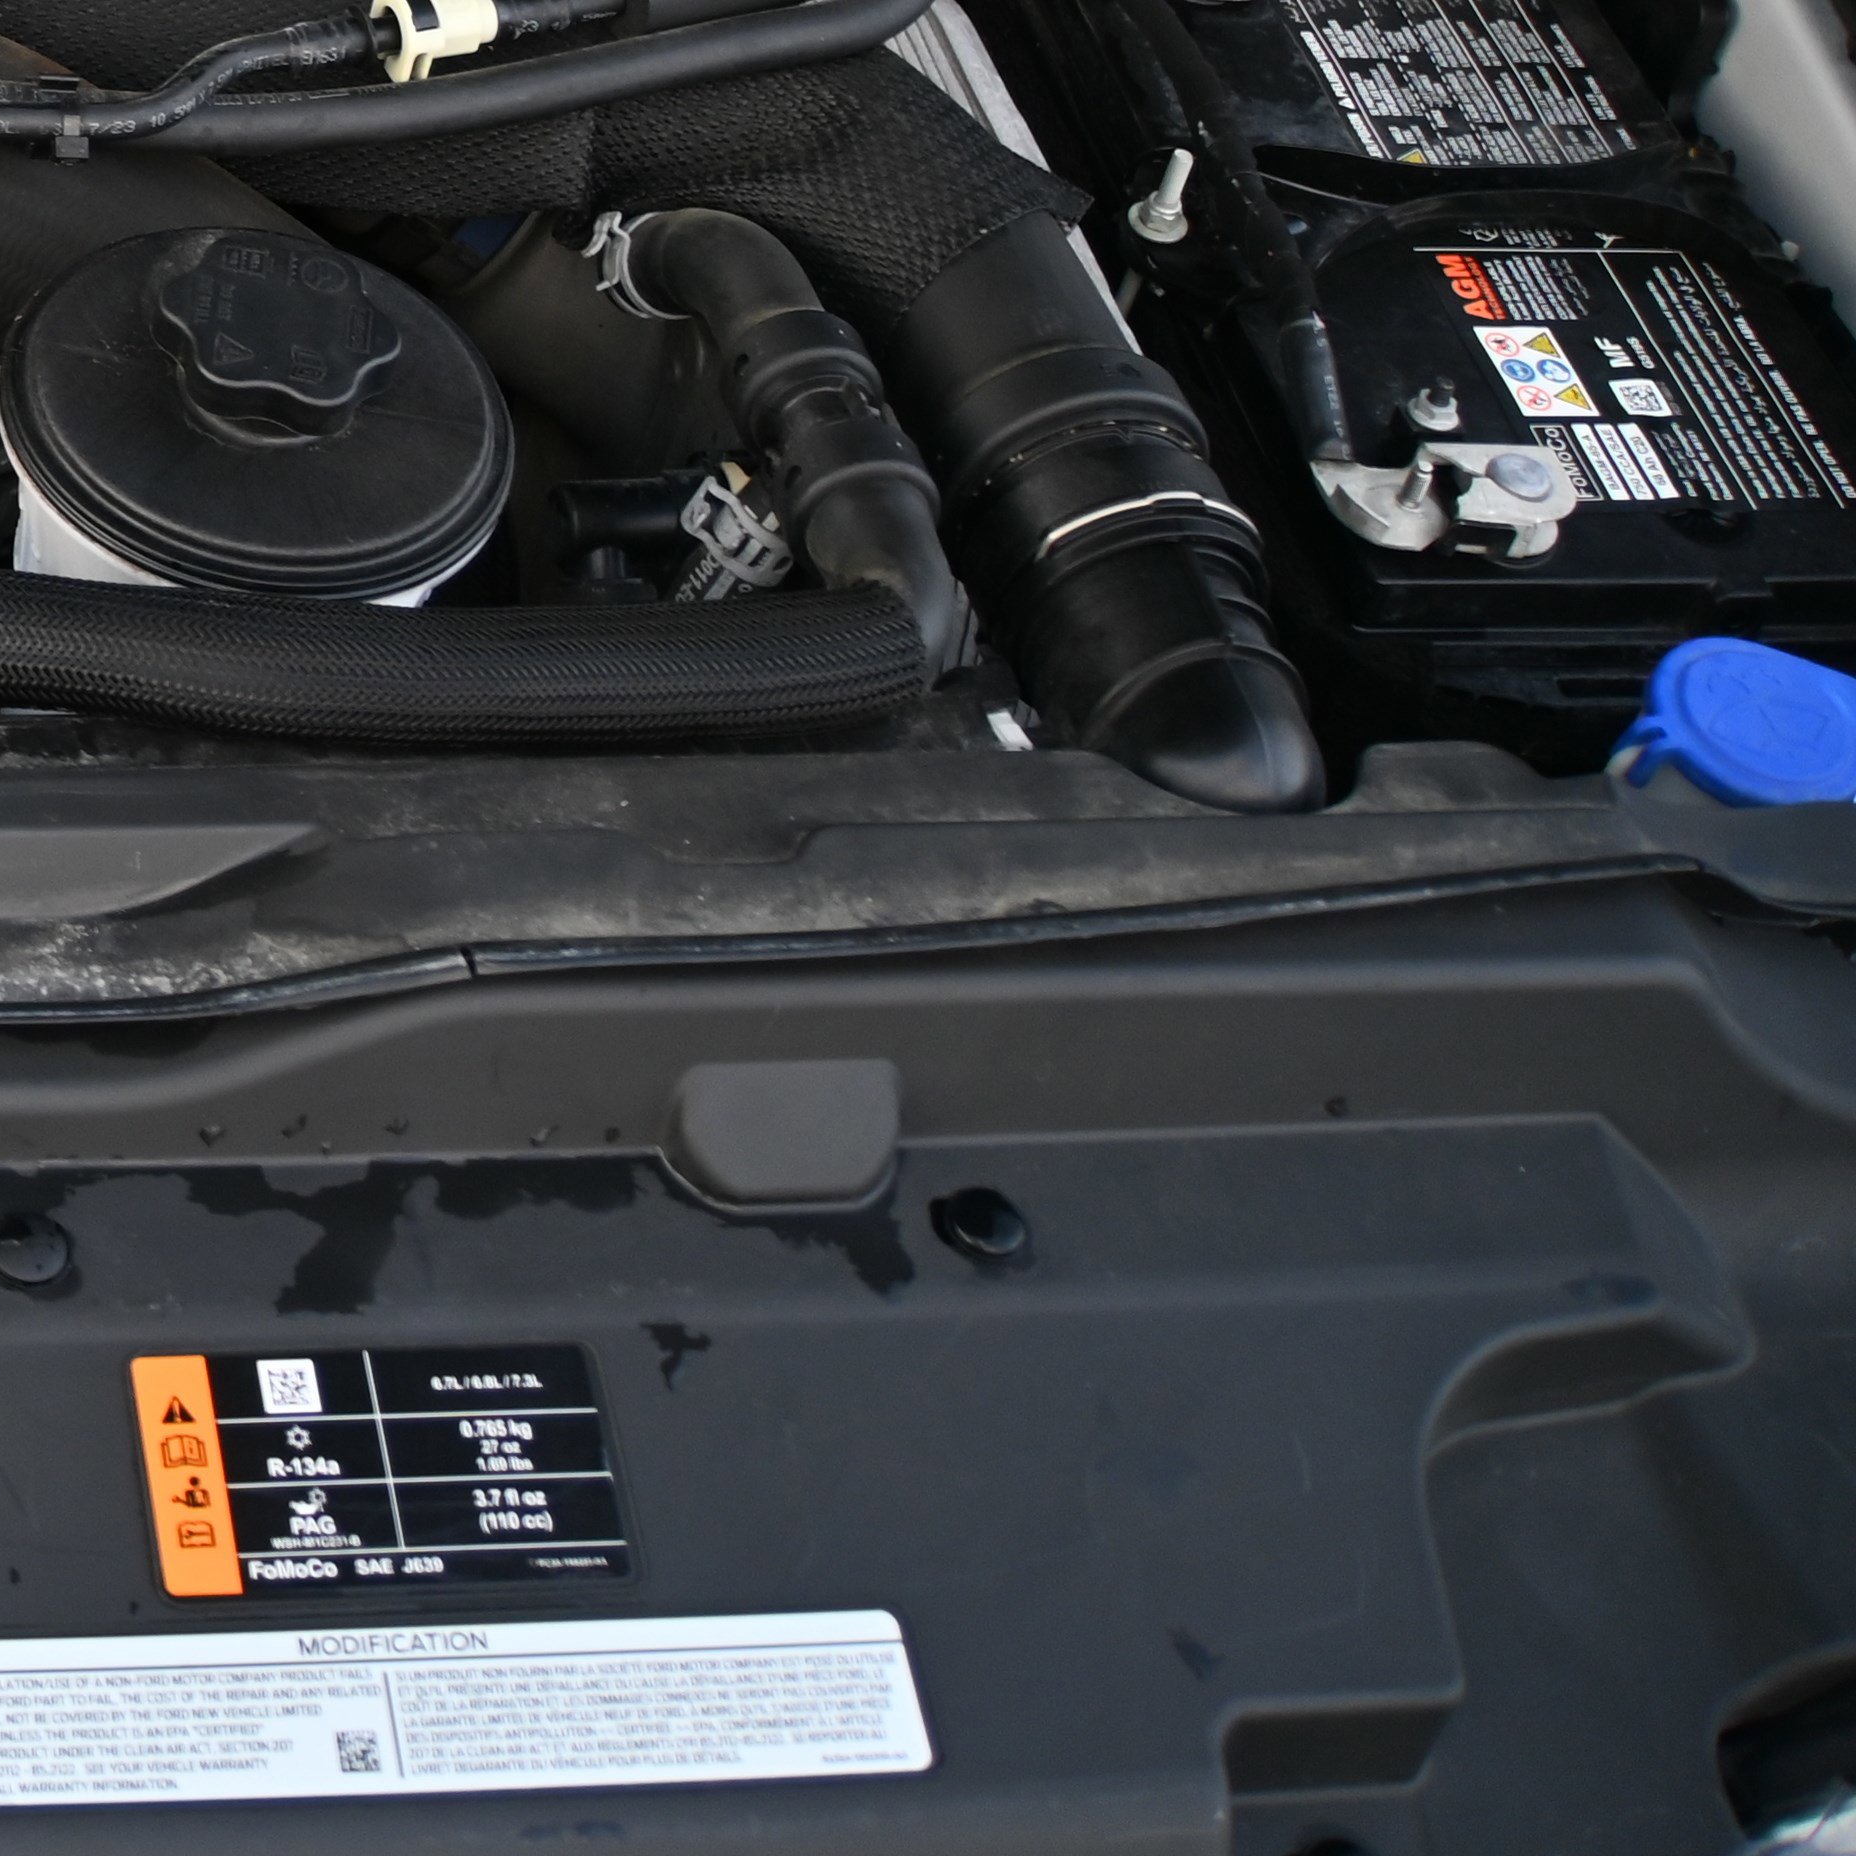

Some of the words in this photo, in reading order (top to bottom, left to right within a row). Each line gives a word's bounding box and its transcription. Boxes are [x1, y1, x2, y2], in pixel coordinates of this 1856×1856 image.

[1431, 254, 1498, 319] AGM
[1592, 336, 1637, 368] MF
[1544, 427, 1596, 499] FoMoCo
[460, 1421, 505, 1440] 0.765
[509, 1421, 534, 1442] kg
[480, 1440, 499, 1455] 27
[501, 1441, 522, 1455] oz
[266, 1457, 341, 1478] R-134a
[509, 1456, 534, 1472] lbs
[473, 1490, 500, 1508] 3.7
[502, 1489, 518, 1508] fl
[520, 1489, 548, 1507] oz
[290, 1515, 337, 1535] PAG
[479, 1512, 521, 1534] (110
[522, 1510, 555, 1532] cc)
[248, 1558, 338, 1580] FoMoCo
[354, 1556, 394, 1576] SAE
[401, 1556, 445, 1575] J639
[298, 1631, 489, 1656] MODIFICATION
